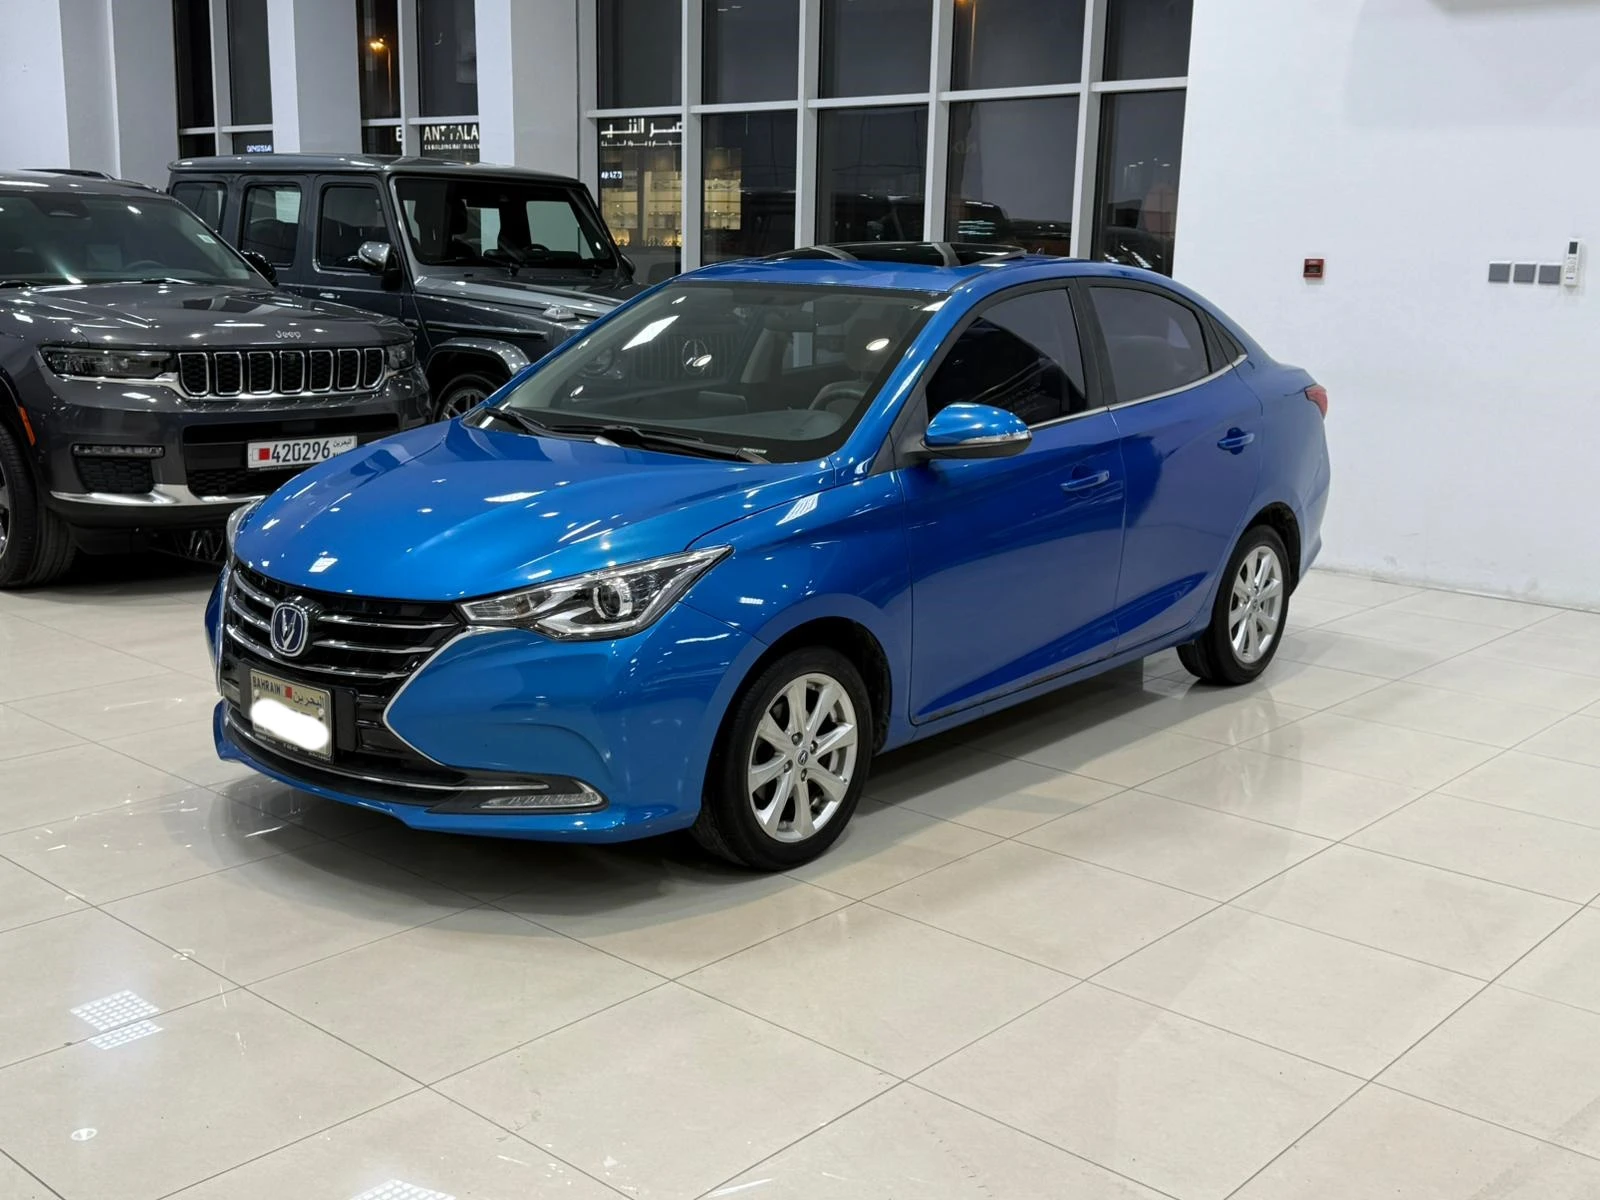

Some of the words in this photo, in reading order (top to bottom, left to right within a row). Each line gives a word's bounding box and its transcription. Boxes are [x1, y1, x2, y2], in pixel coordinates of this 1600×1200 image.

[275, 330, 301, 340] Jeep
[271, 440, 330, 463] 420296
[252, 676, 281, 696] BAHRAIN
[294, 691, 324, 710] البحرين
